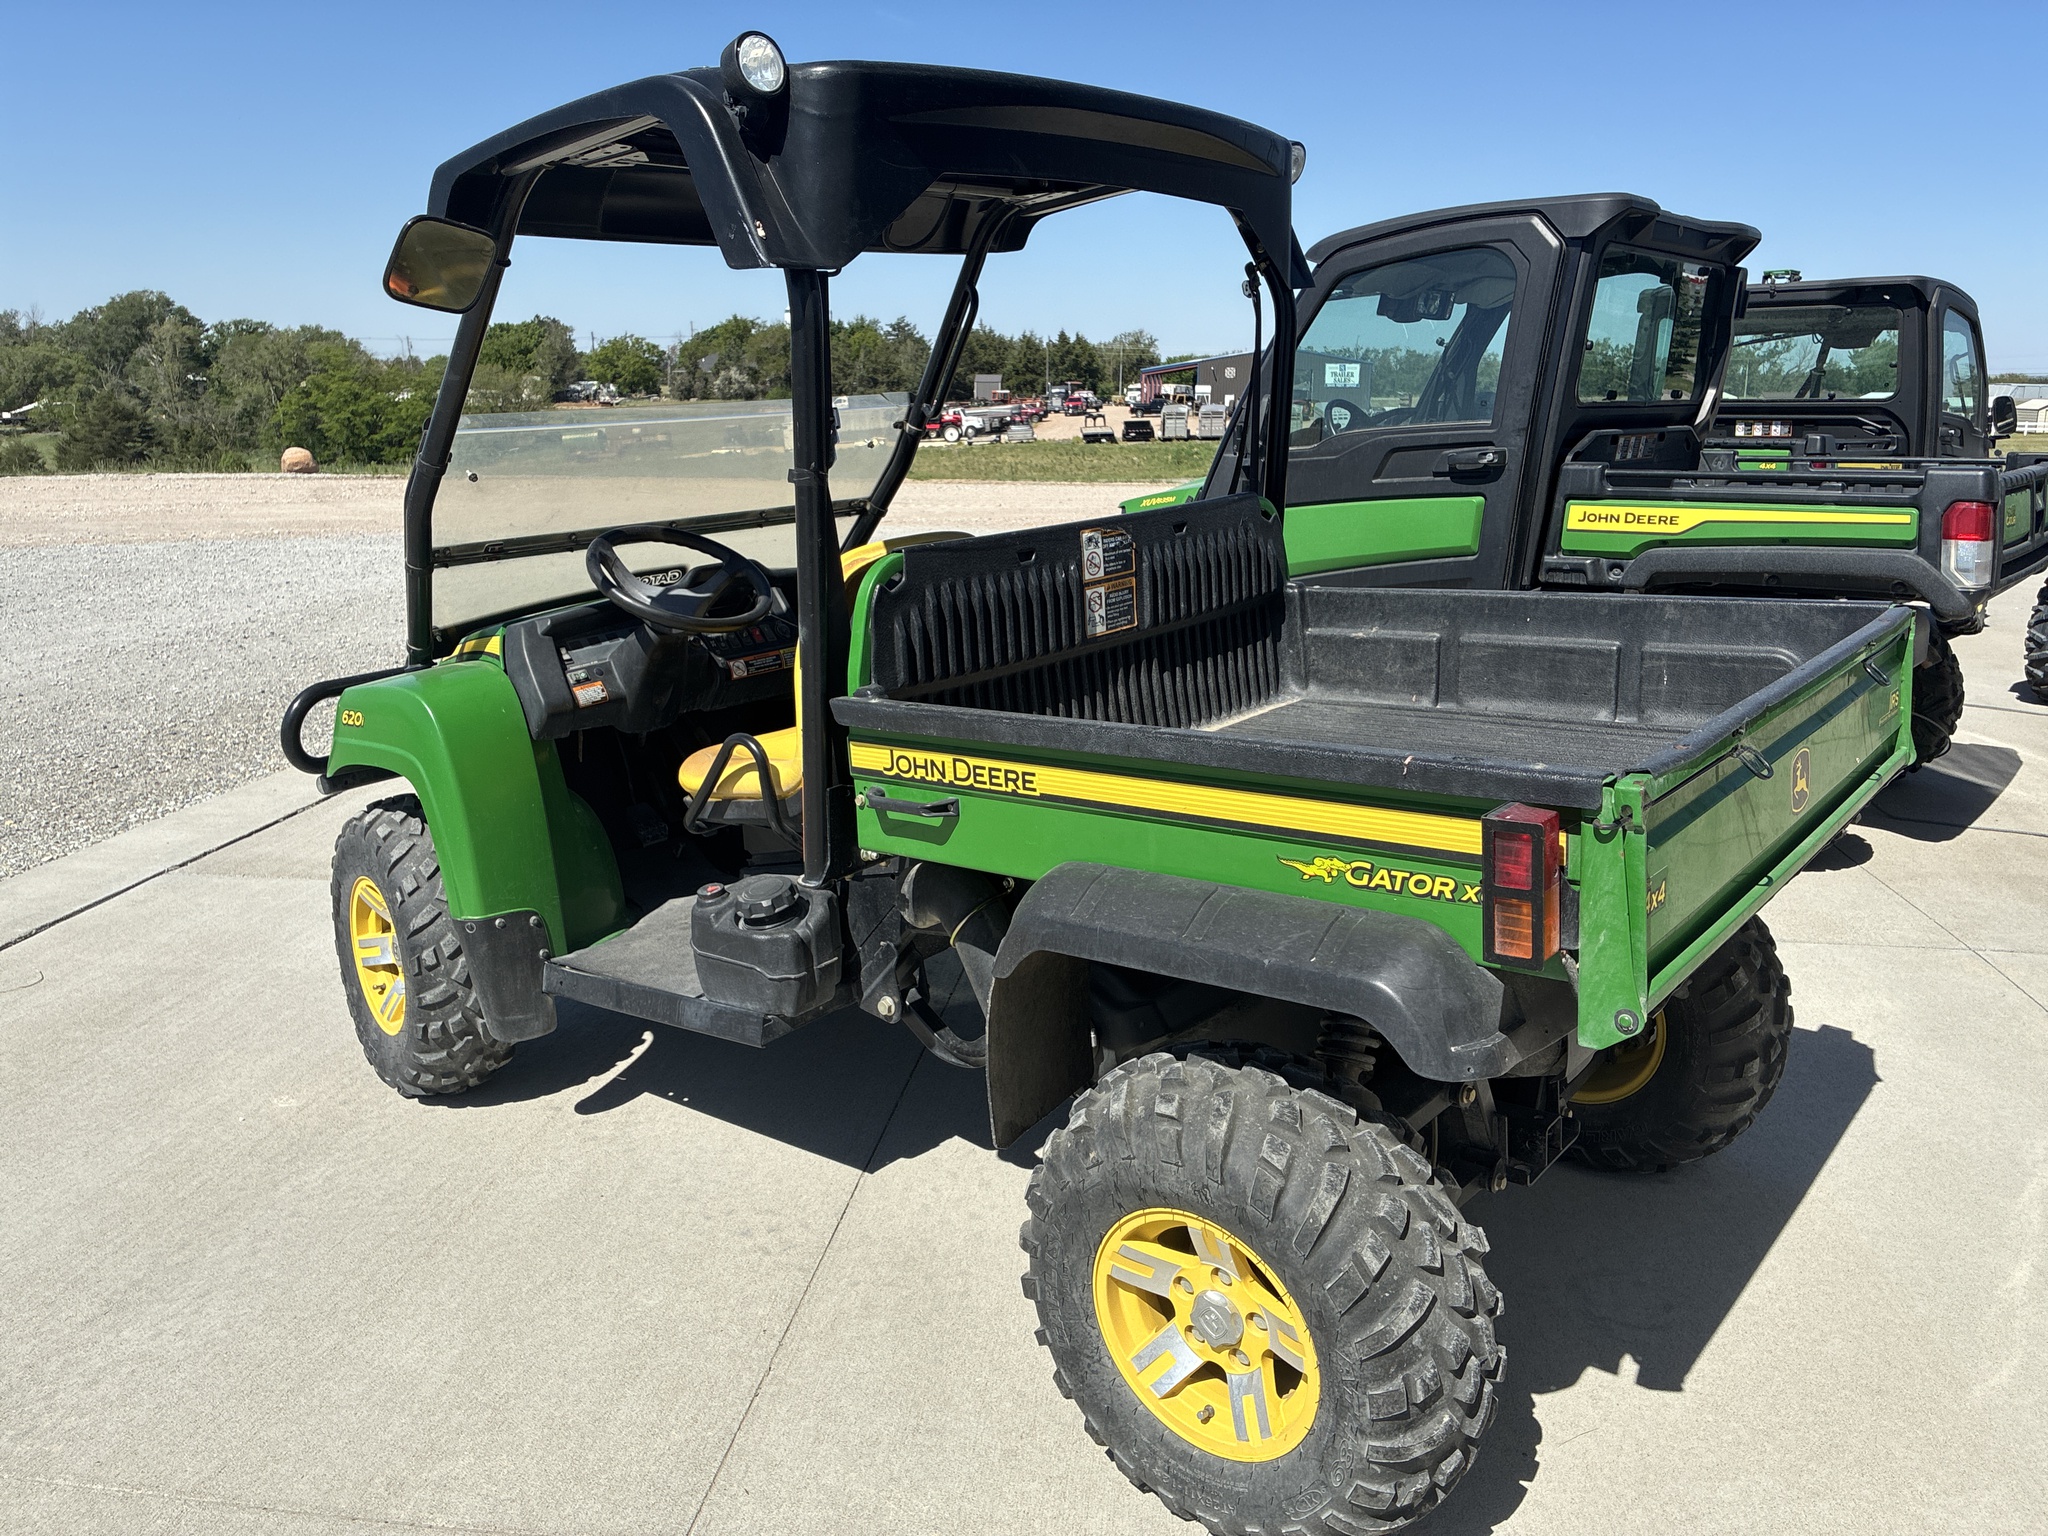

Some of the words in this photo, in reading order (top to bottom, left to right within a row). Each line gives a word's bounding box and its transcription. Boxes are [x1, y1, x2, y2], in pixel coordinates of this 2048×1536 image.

[1578, 511, 1620, 524] JOHN
[1624, 512, 1680, 526] DEERE
[883, 750, 946, 781] JOHN
[952, 757, 1038, 793] DEERE
[1344, 861, 1456, 902] GATOR
